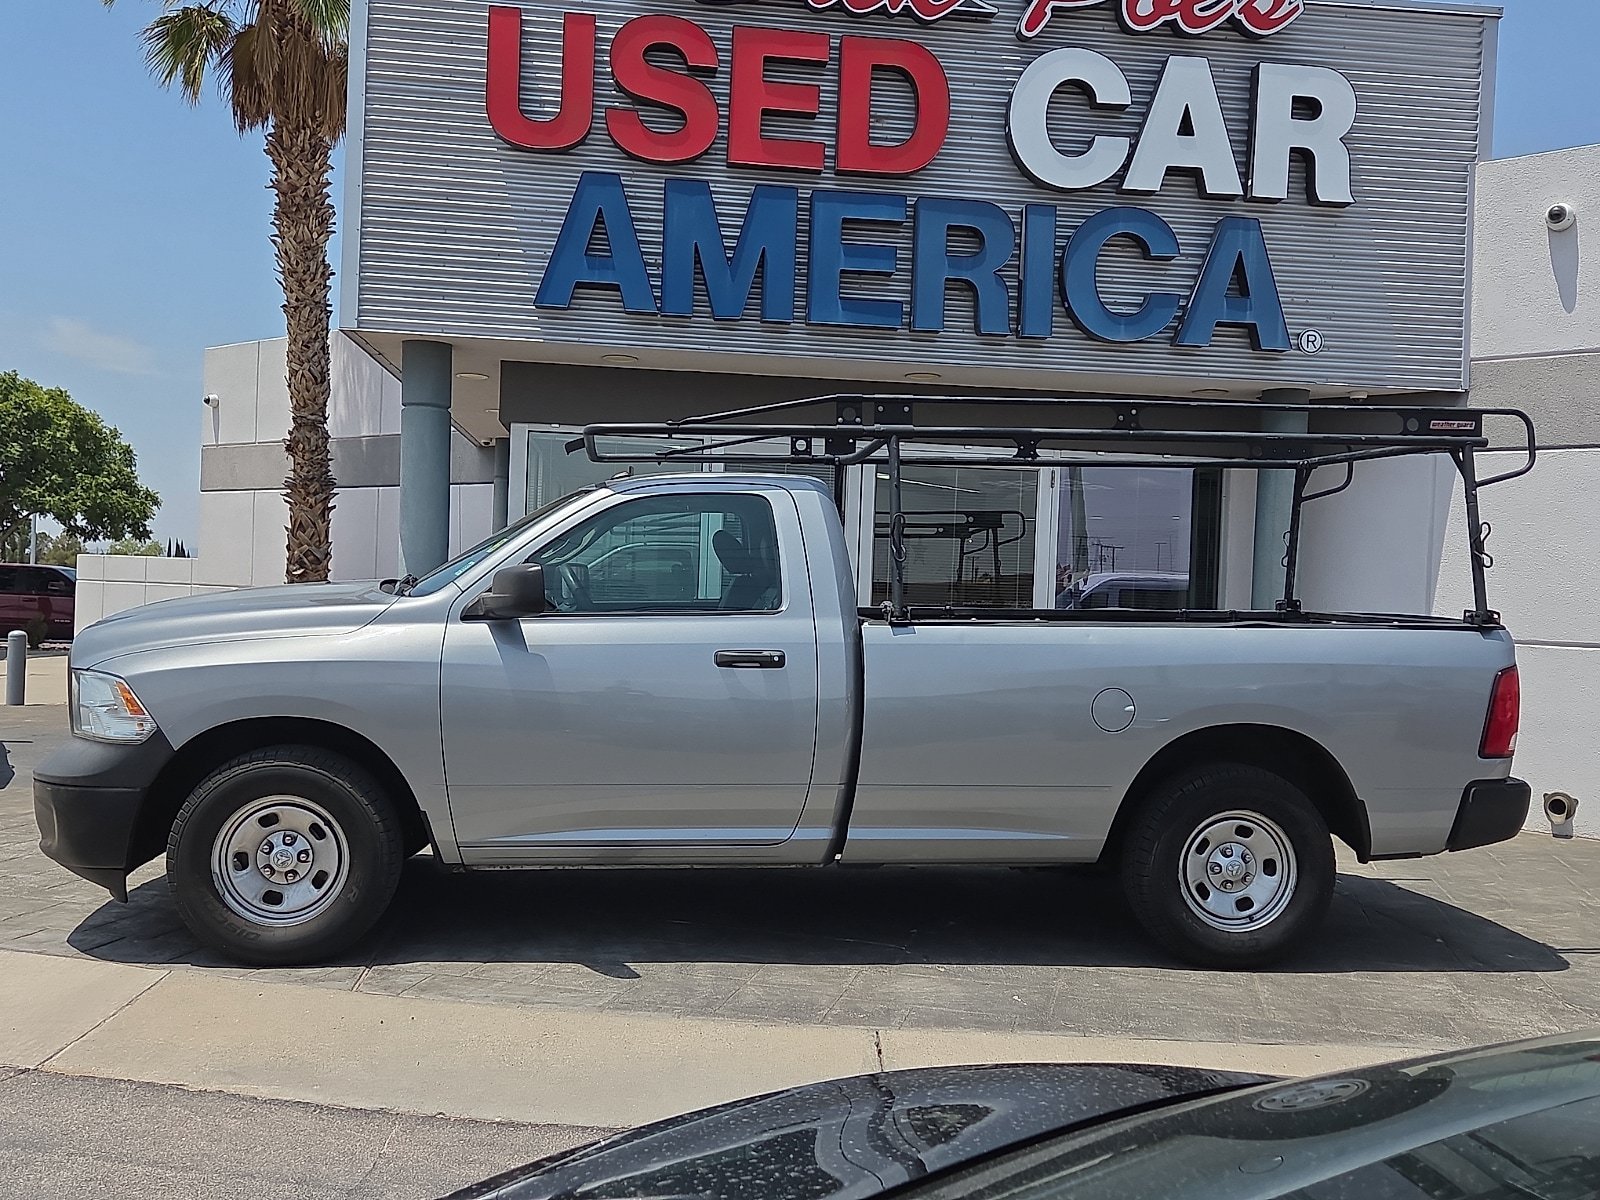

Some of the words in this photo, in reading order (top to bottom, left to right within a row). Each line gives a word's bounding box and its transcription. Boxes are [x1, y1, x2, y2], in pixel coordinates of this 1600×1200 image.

[485, 5, 950, 177] USED
[1006, 46, 1357, 206] CAR
[533, 170, 1293, 353] AMERICA
